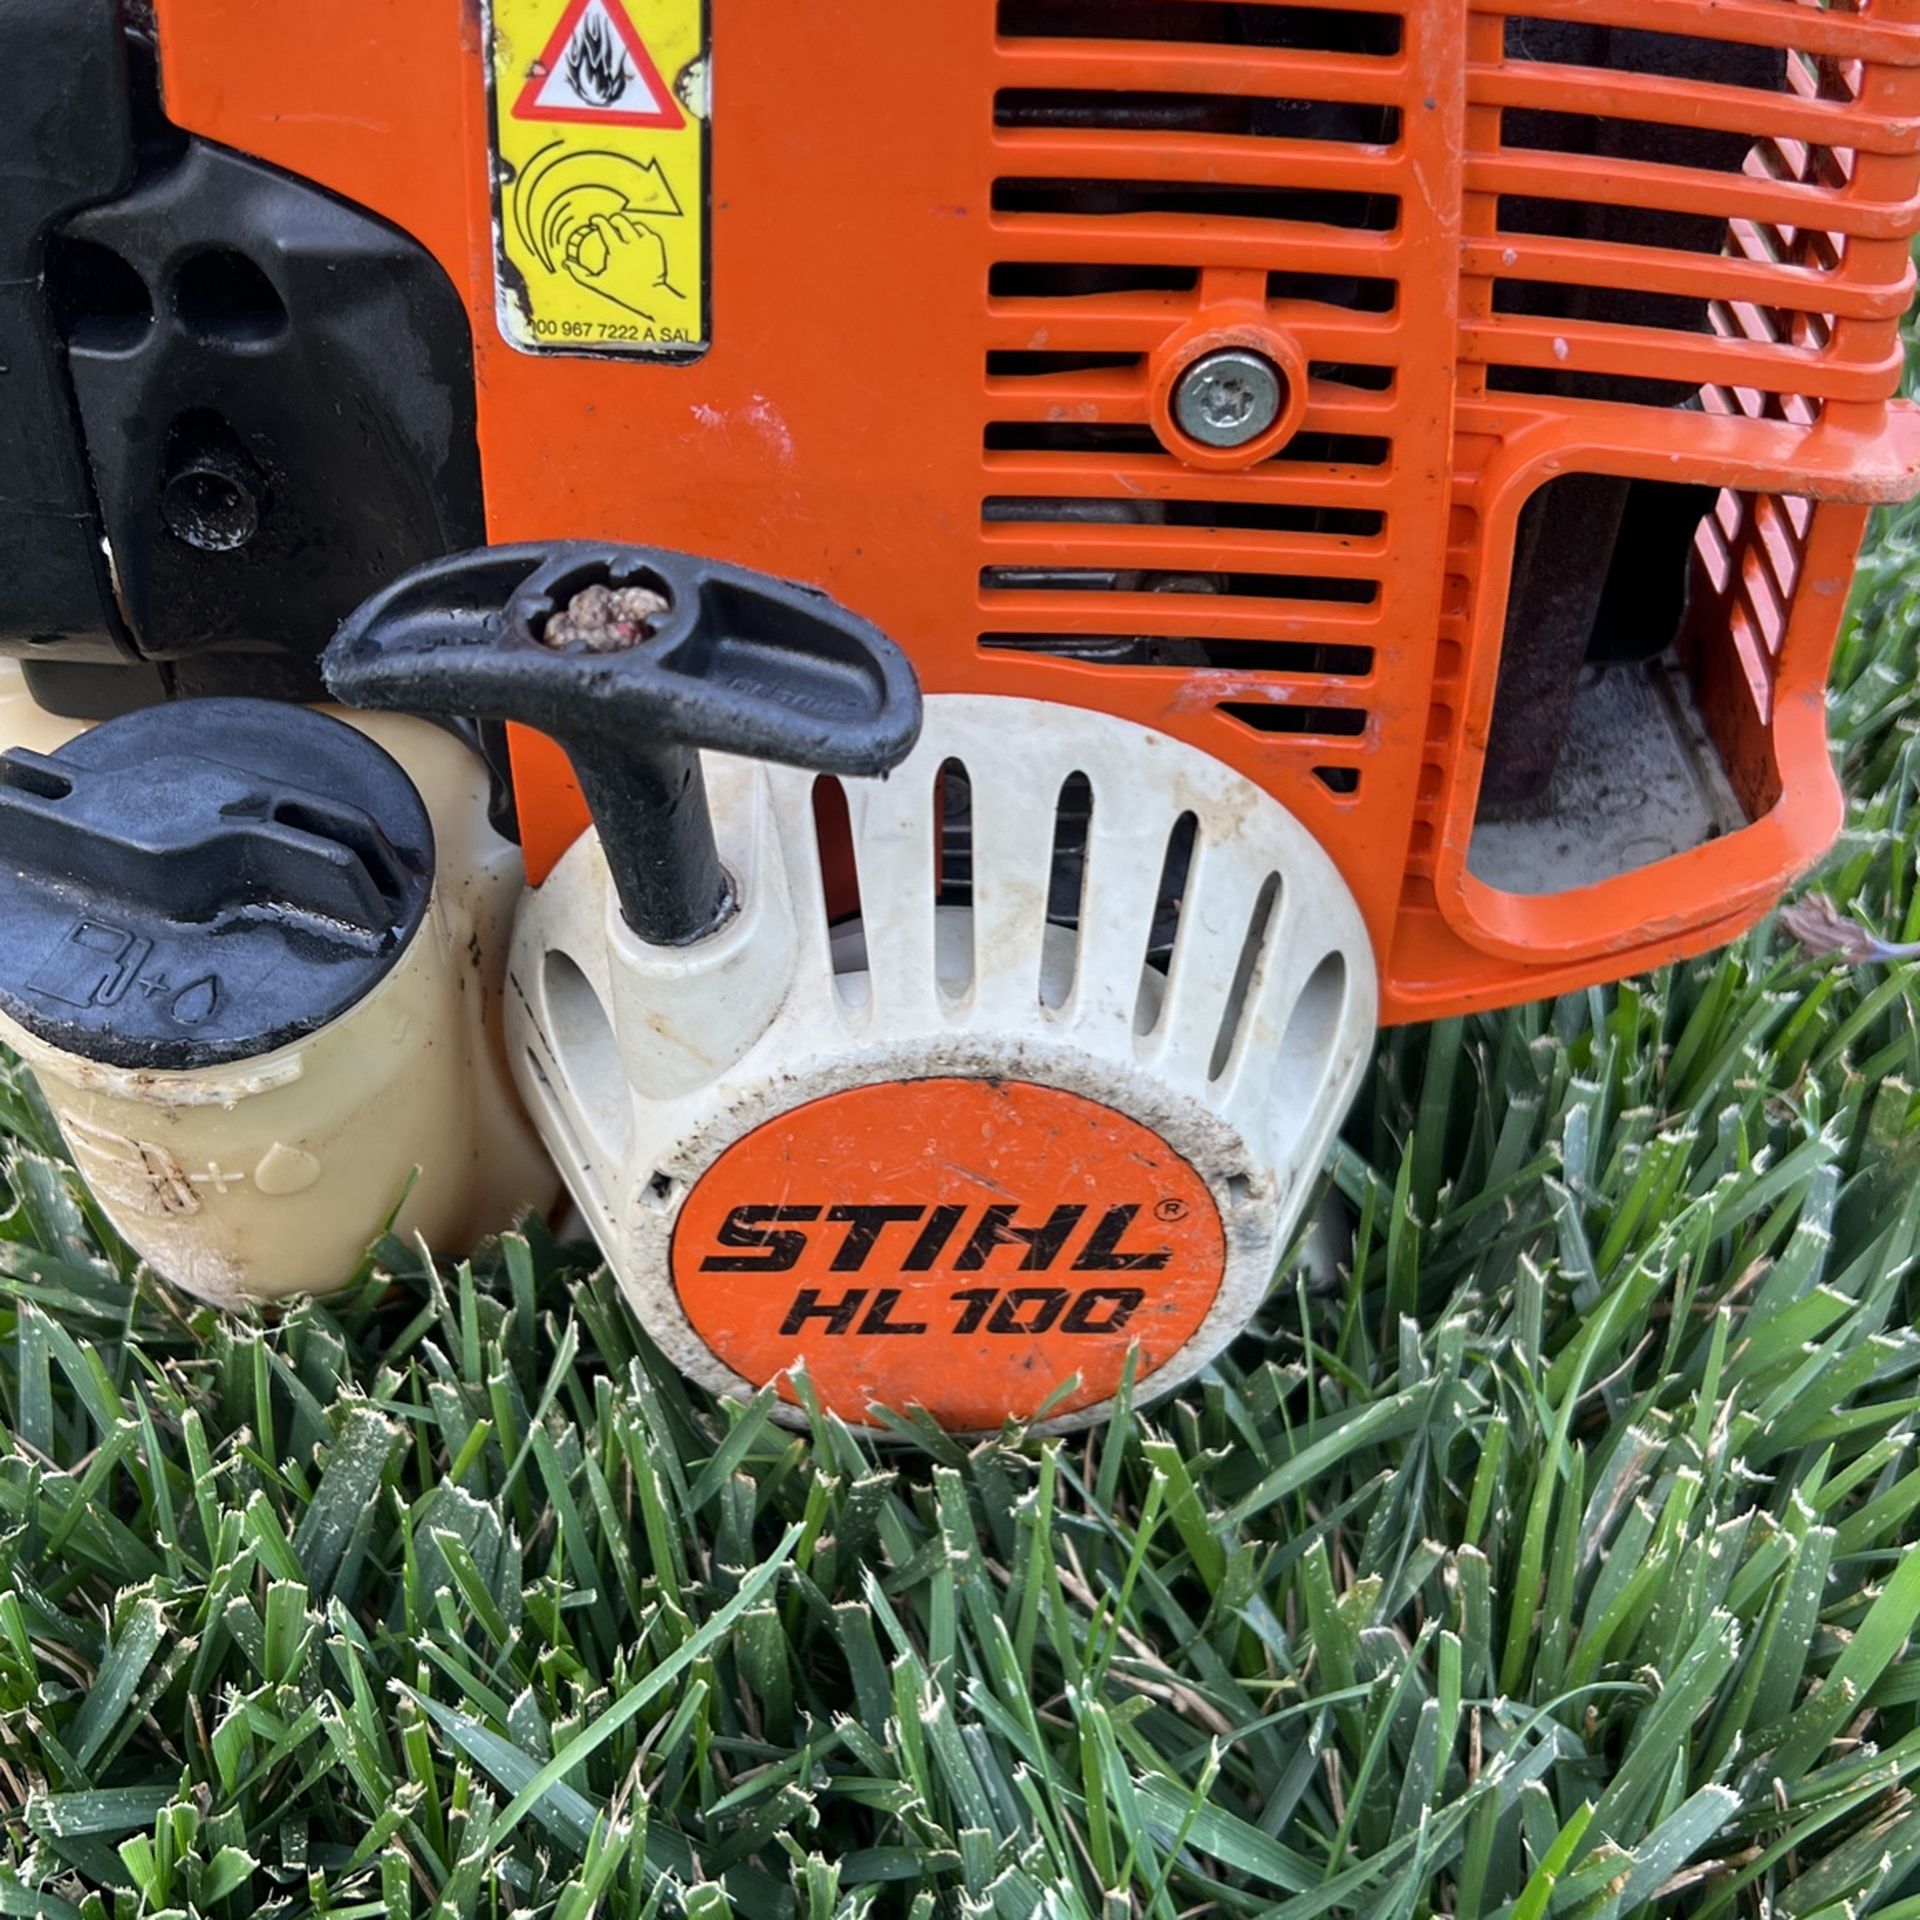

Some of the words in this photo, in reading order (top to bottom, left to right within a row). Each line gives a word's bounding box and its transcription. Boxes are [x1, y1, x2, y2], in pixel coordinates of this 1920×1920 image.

[561, 321, 593, 337] 967
[598, 323, 639, 340] 7222
[643, 327, 657, 342] A
[660, 327, 697, 344] SAL
[698, 1204, 1174, 1272] STIHL
[778, 1288, 927, 1335] HL
[949, 1287, 1146, 1335] 100
